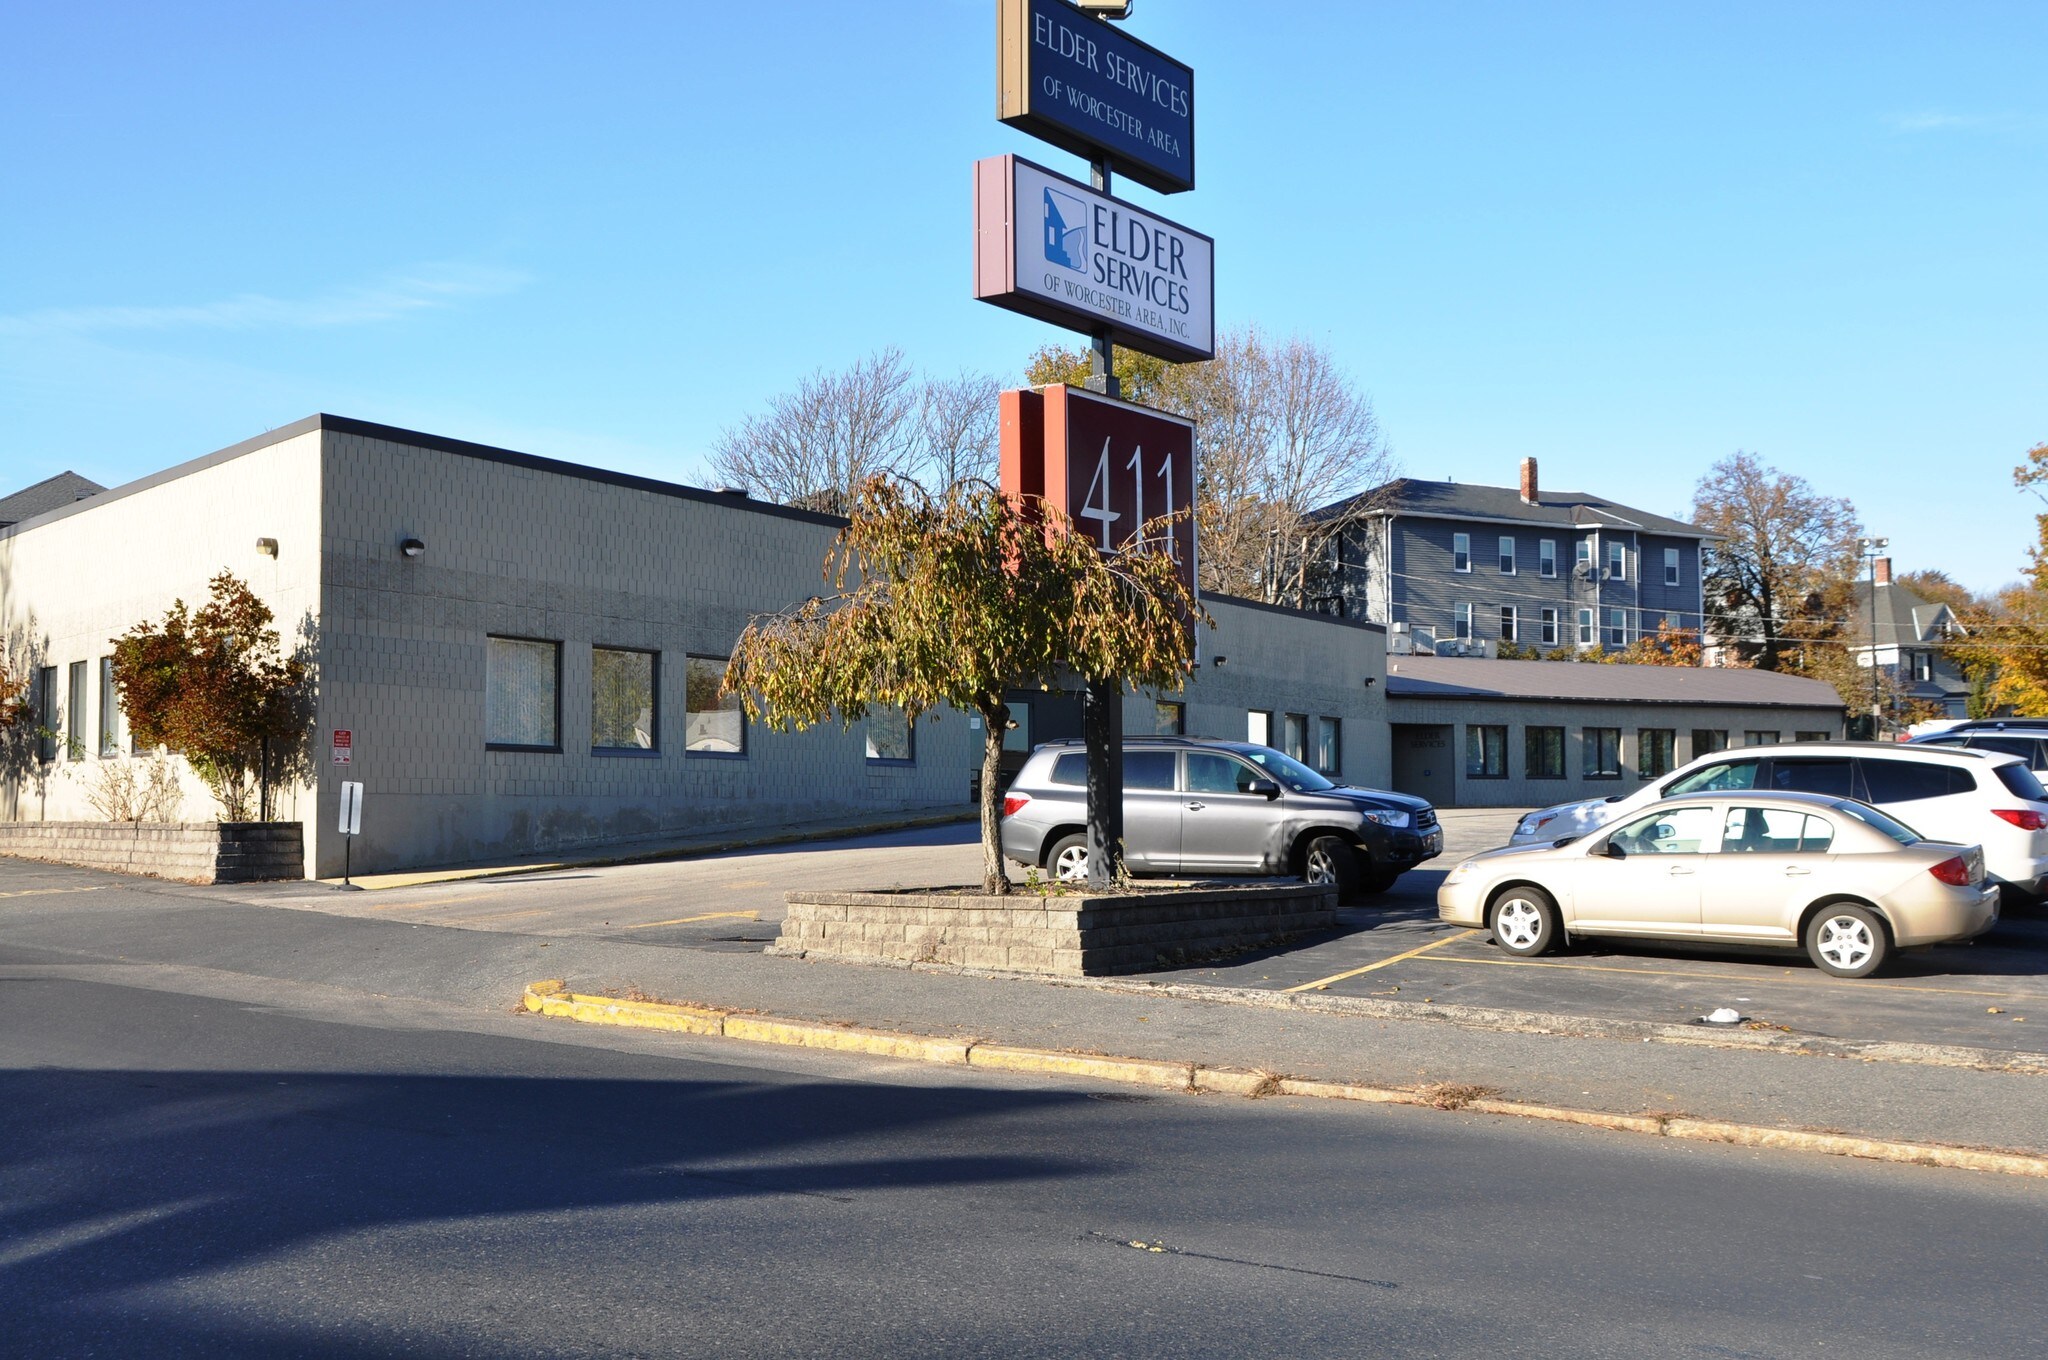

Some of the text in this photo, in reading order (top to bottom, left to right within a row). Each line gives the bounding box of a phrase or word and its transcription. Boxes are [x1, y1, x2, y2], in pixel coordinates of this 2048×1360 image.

[1035, 12, 1188, 118] ELDER SERVICES
[1043, 75, 1180, 158] OF WORCESTER AREA
[1093, 203, 1189, 281] ELDER
[1043, 273, 1190, 339] OF WORCESTER AREA, INC.
[1093, 252, 1190, 315] SERVICES
[1080, 435, 1182, 566] 411
